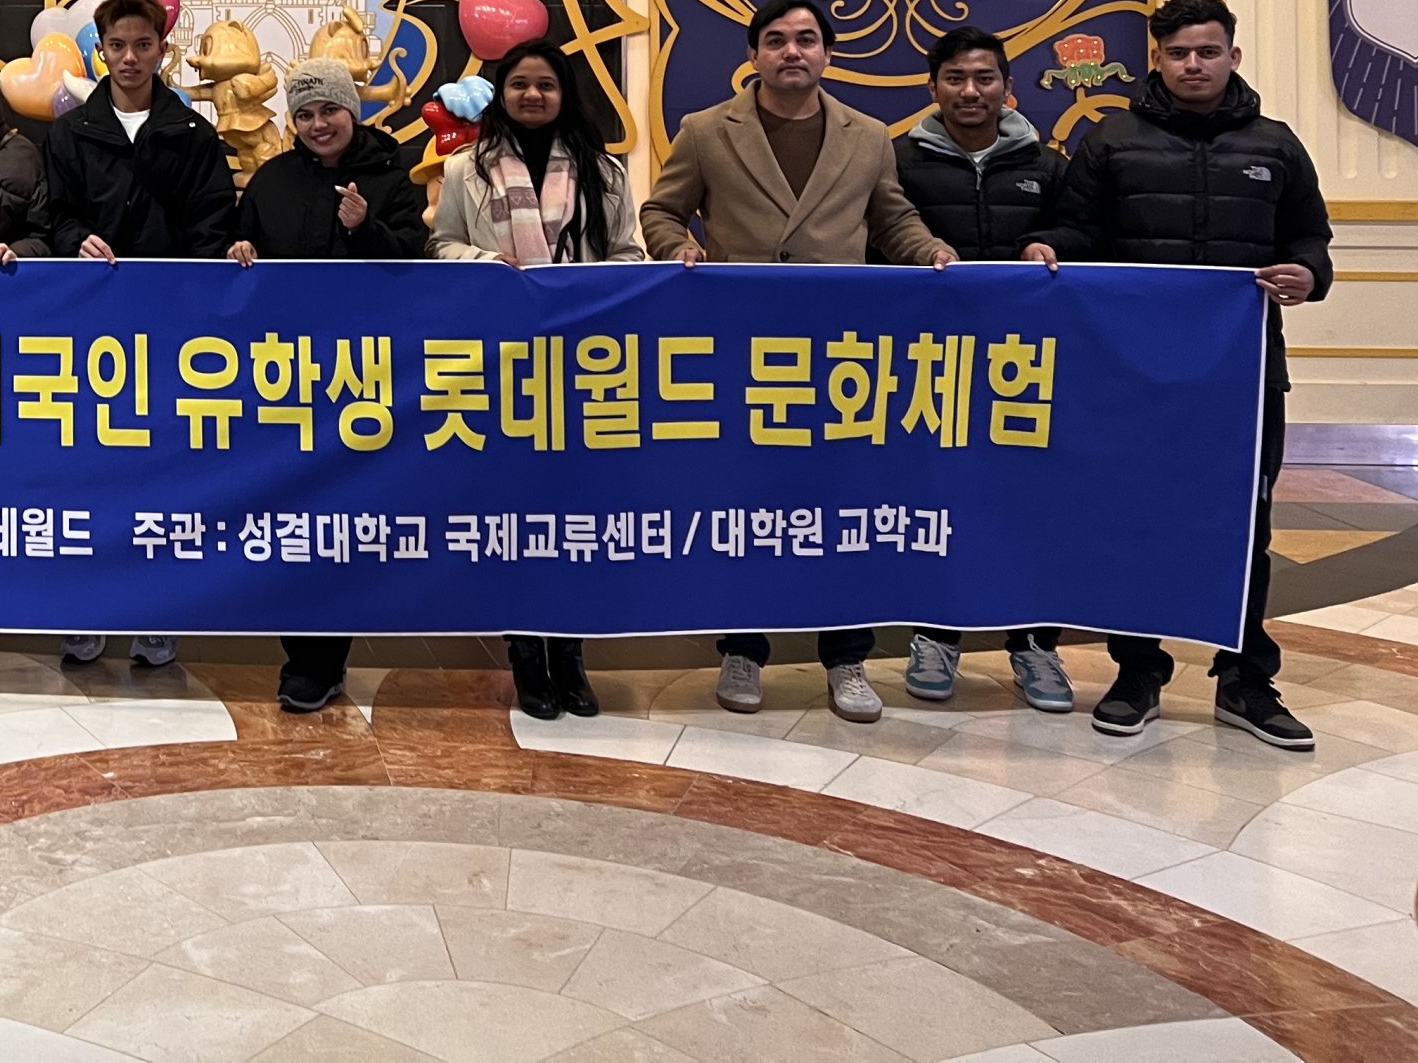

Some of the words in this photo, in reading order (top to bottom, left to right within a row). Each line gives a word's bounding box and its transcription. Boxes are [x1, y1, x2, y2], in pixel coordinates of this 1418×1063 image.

[175, 332, 394, 452] 유학생
[420, 333, 720, 451] 롯데월드
[745, 331, 1056, 448] 문화체험
[238, 512, 429, 563] 성결대학교
[445, 511, 672, 562] 국제교류센터
[711, 507, 824, 557] 대학원
[836, 504, 952, 557] 교학과
